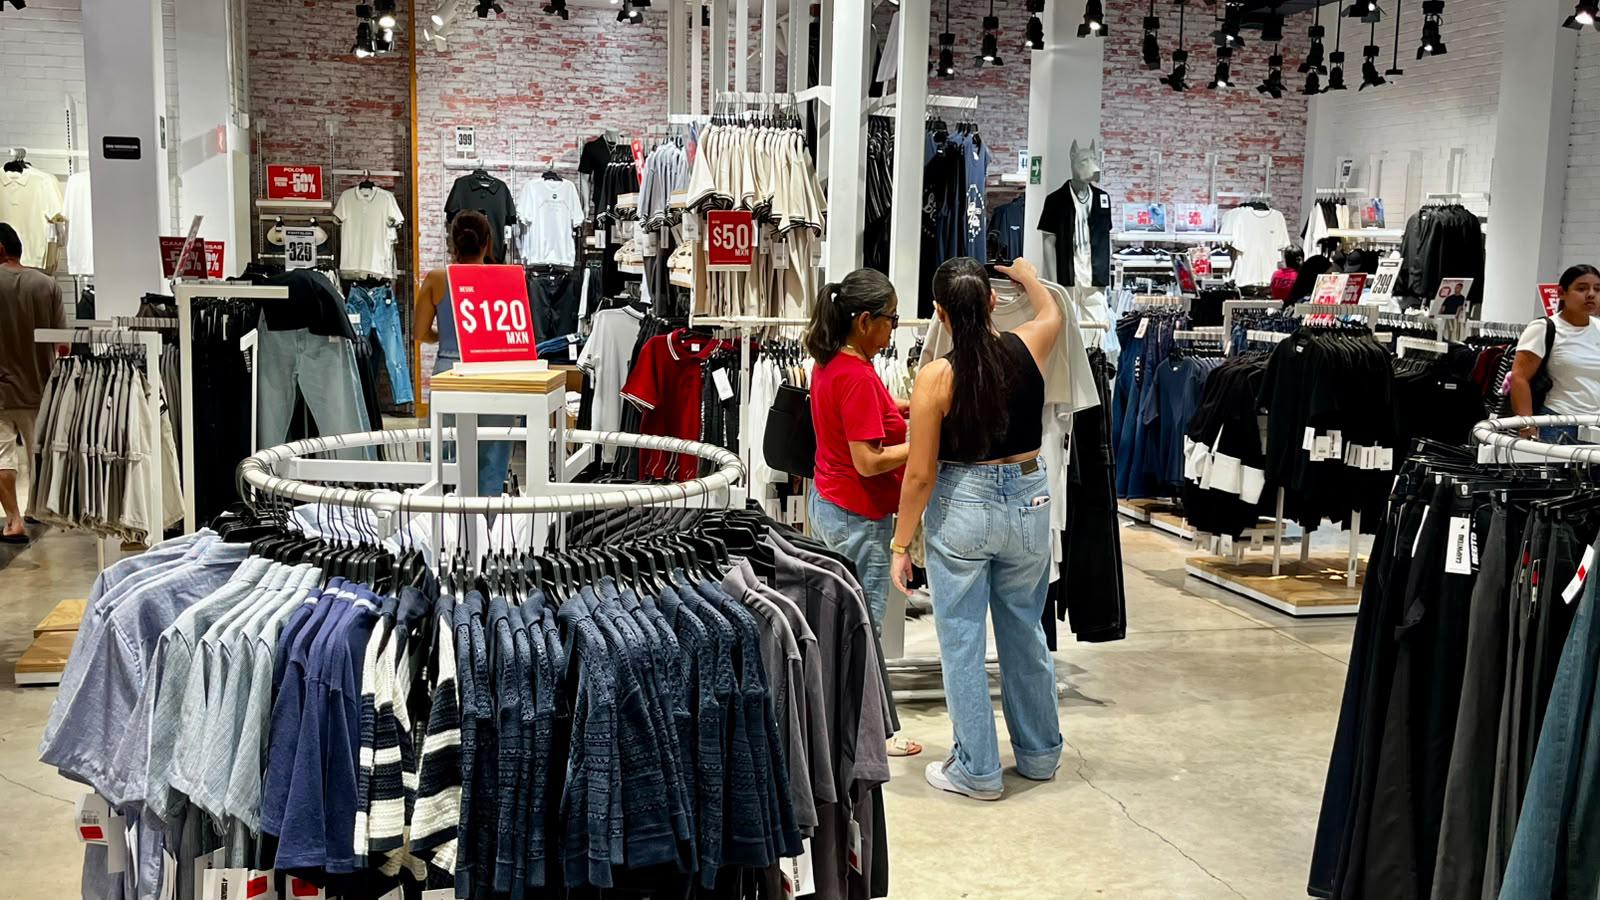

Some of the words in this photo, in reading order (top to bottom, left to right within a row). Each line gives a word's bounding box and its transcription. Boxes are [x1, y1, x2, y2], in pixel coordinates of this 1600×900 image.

[458, 133, 472, 145] 399
[288, 172, 316, 193] -50%
[713, 223, 749, 250] $50
[734, 248, 749, 256] MXN
[1371, 273, 1394, 294] 299
[459, 298, 527, 334] $120
[505, 331, 529, 344] MXN
